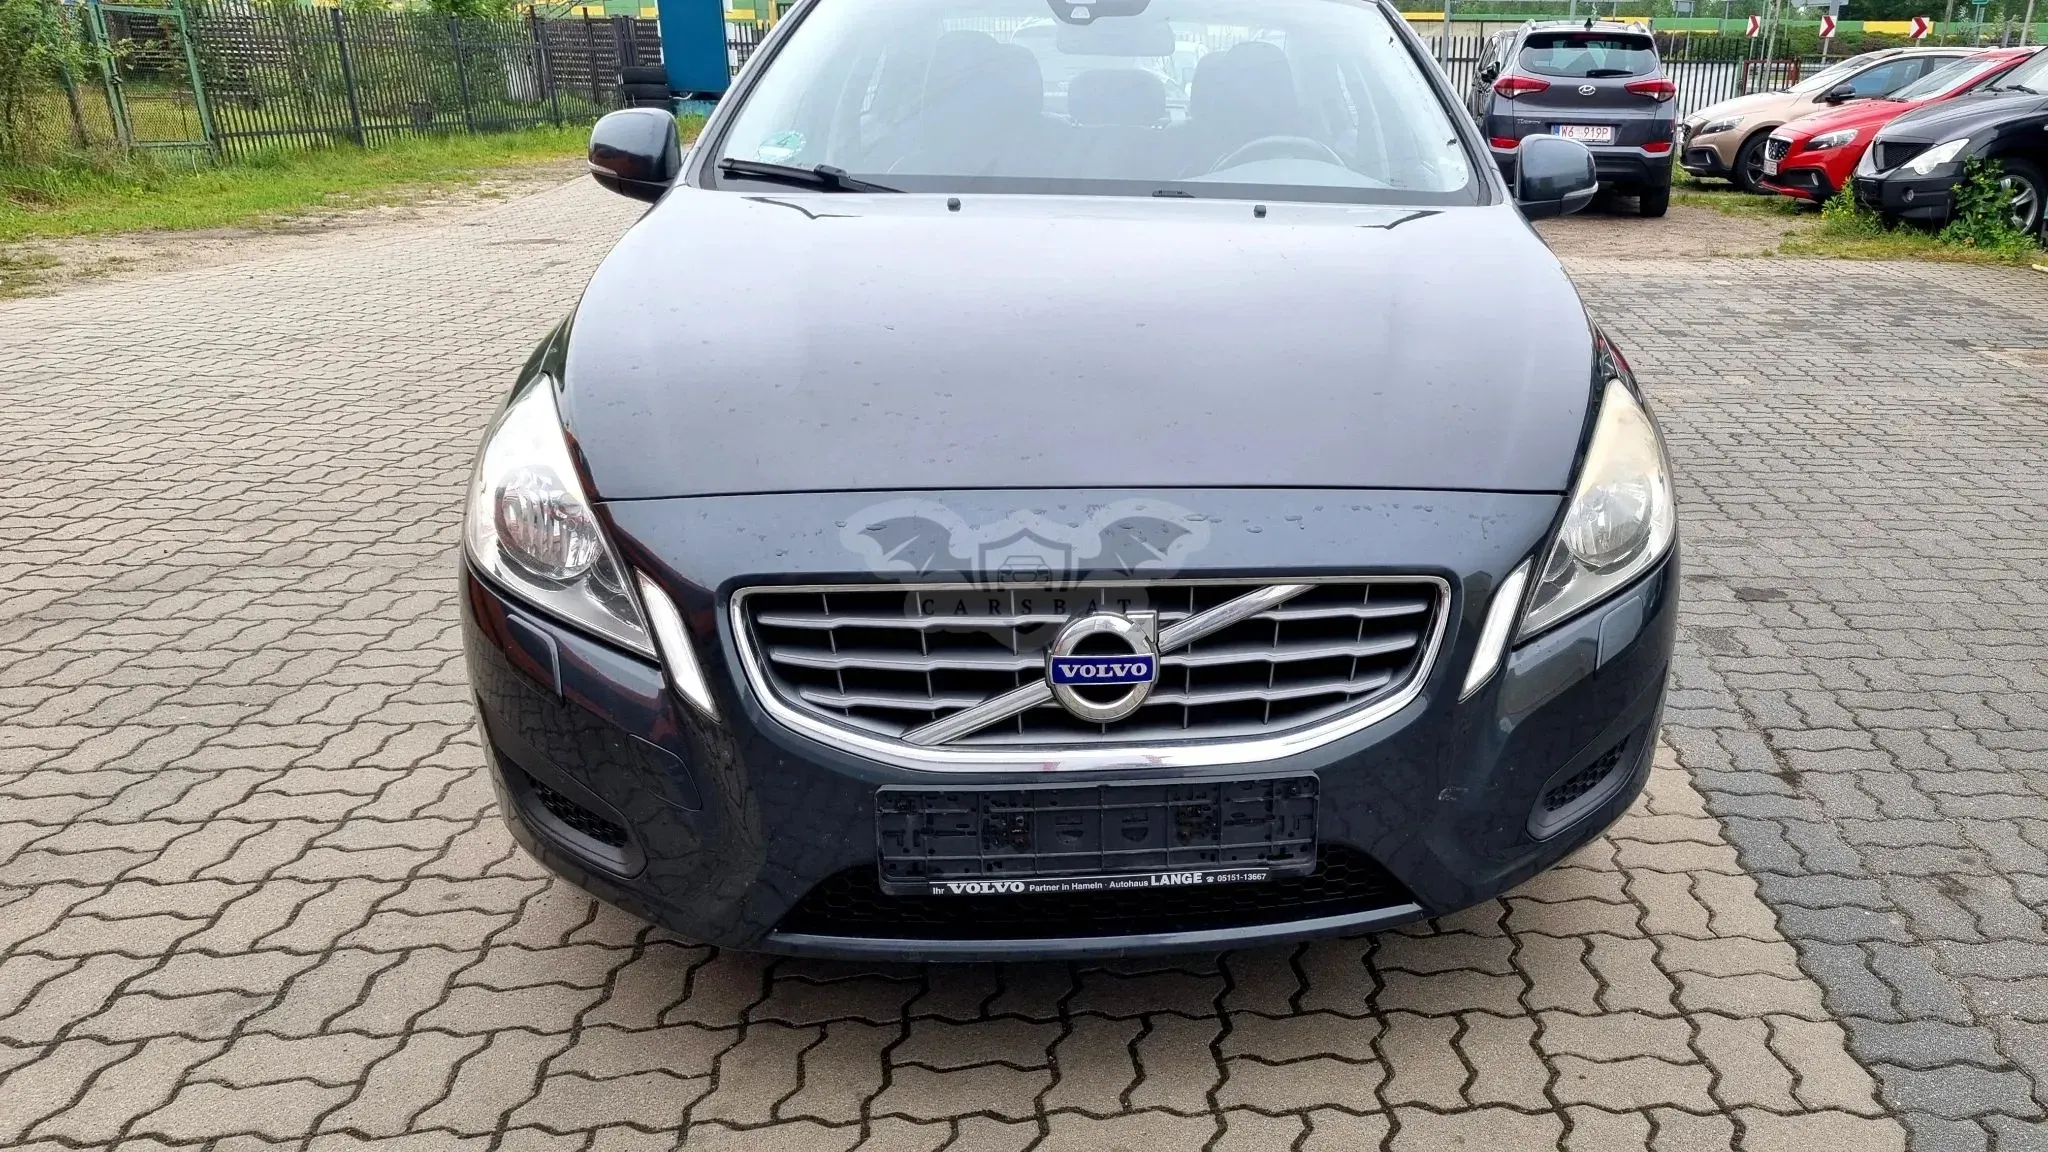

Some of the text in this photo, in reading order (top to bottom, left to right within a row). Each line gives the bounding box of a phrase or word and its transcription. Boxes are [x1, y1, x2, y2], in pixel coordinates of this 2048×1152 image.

[1561, 126, 1609, 138] W6 919P
[1058, 663, 1148, 678] VOLVO
[932, 873, 1267, 895] Ihr VOLVO Partner in Hameln Autohaus LANGE 05151-13667
